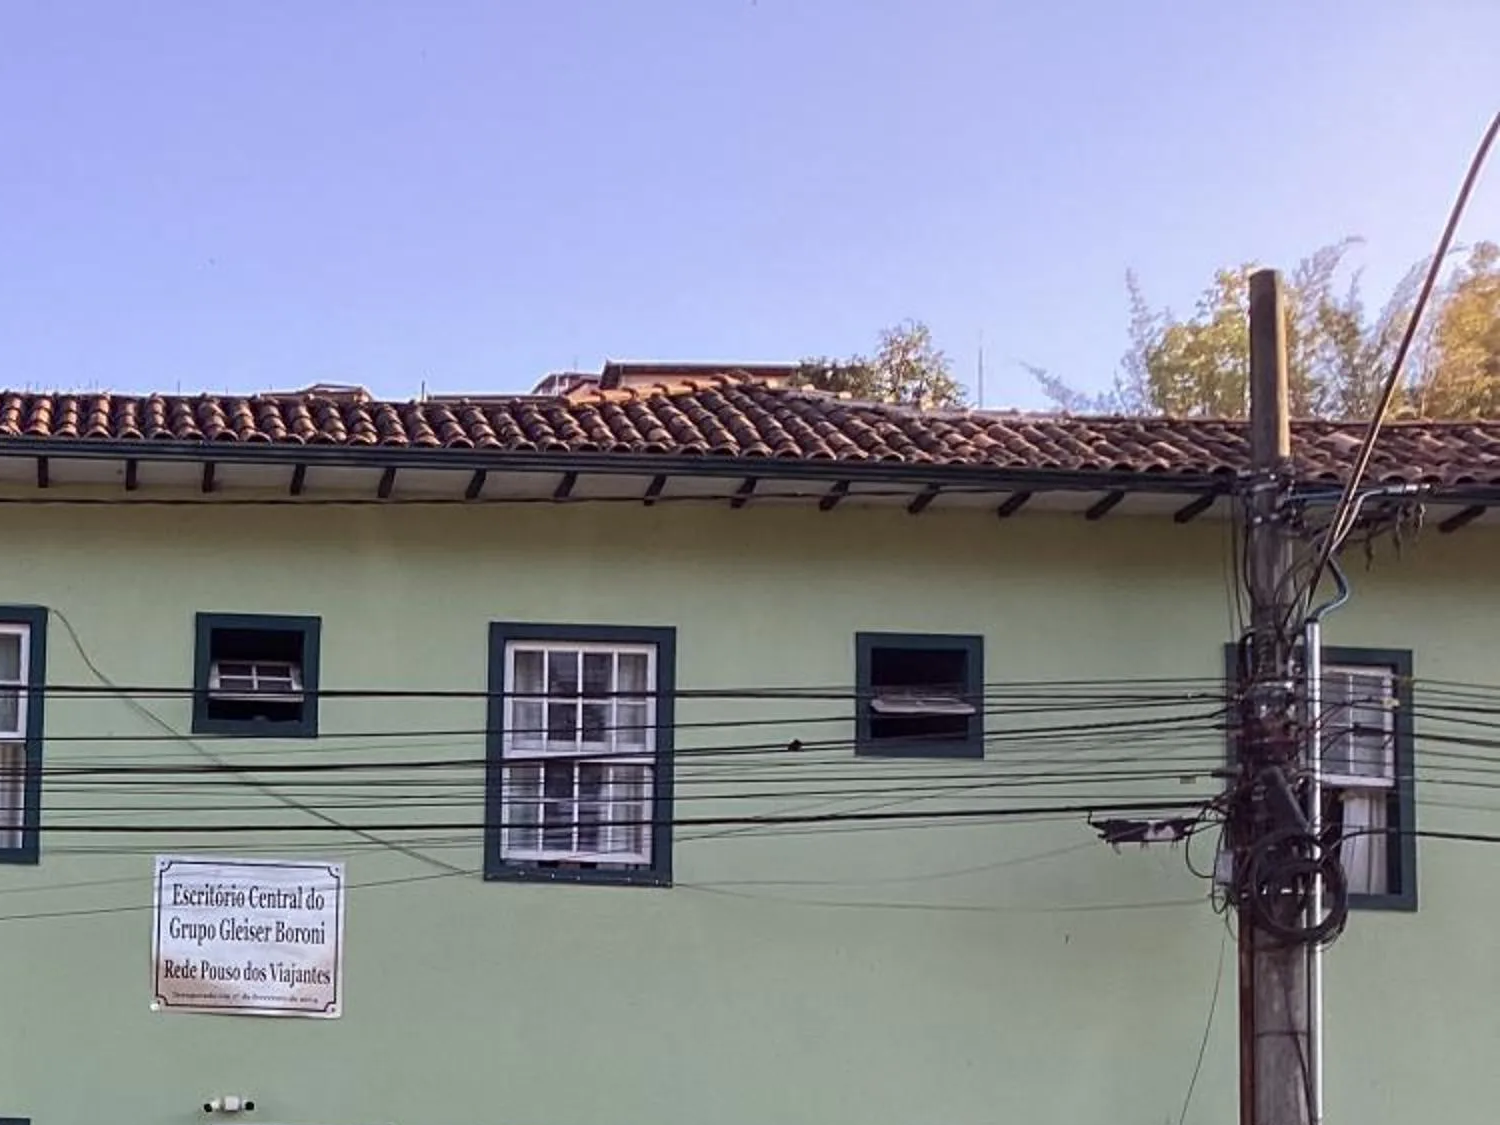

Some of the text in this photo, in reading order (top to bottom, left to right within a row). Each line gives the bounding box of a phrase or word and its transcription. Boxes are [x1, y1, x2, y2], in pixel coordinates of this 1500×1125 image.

[172, 884, 325, 911] Escritório Central do
[169, 915, 325, 946] Grupo Gleiser Boroni
[163, 959, 331, 988] Rede Pouso dos Viajantes
